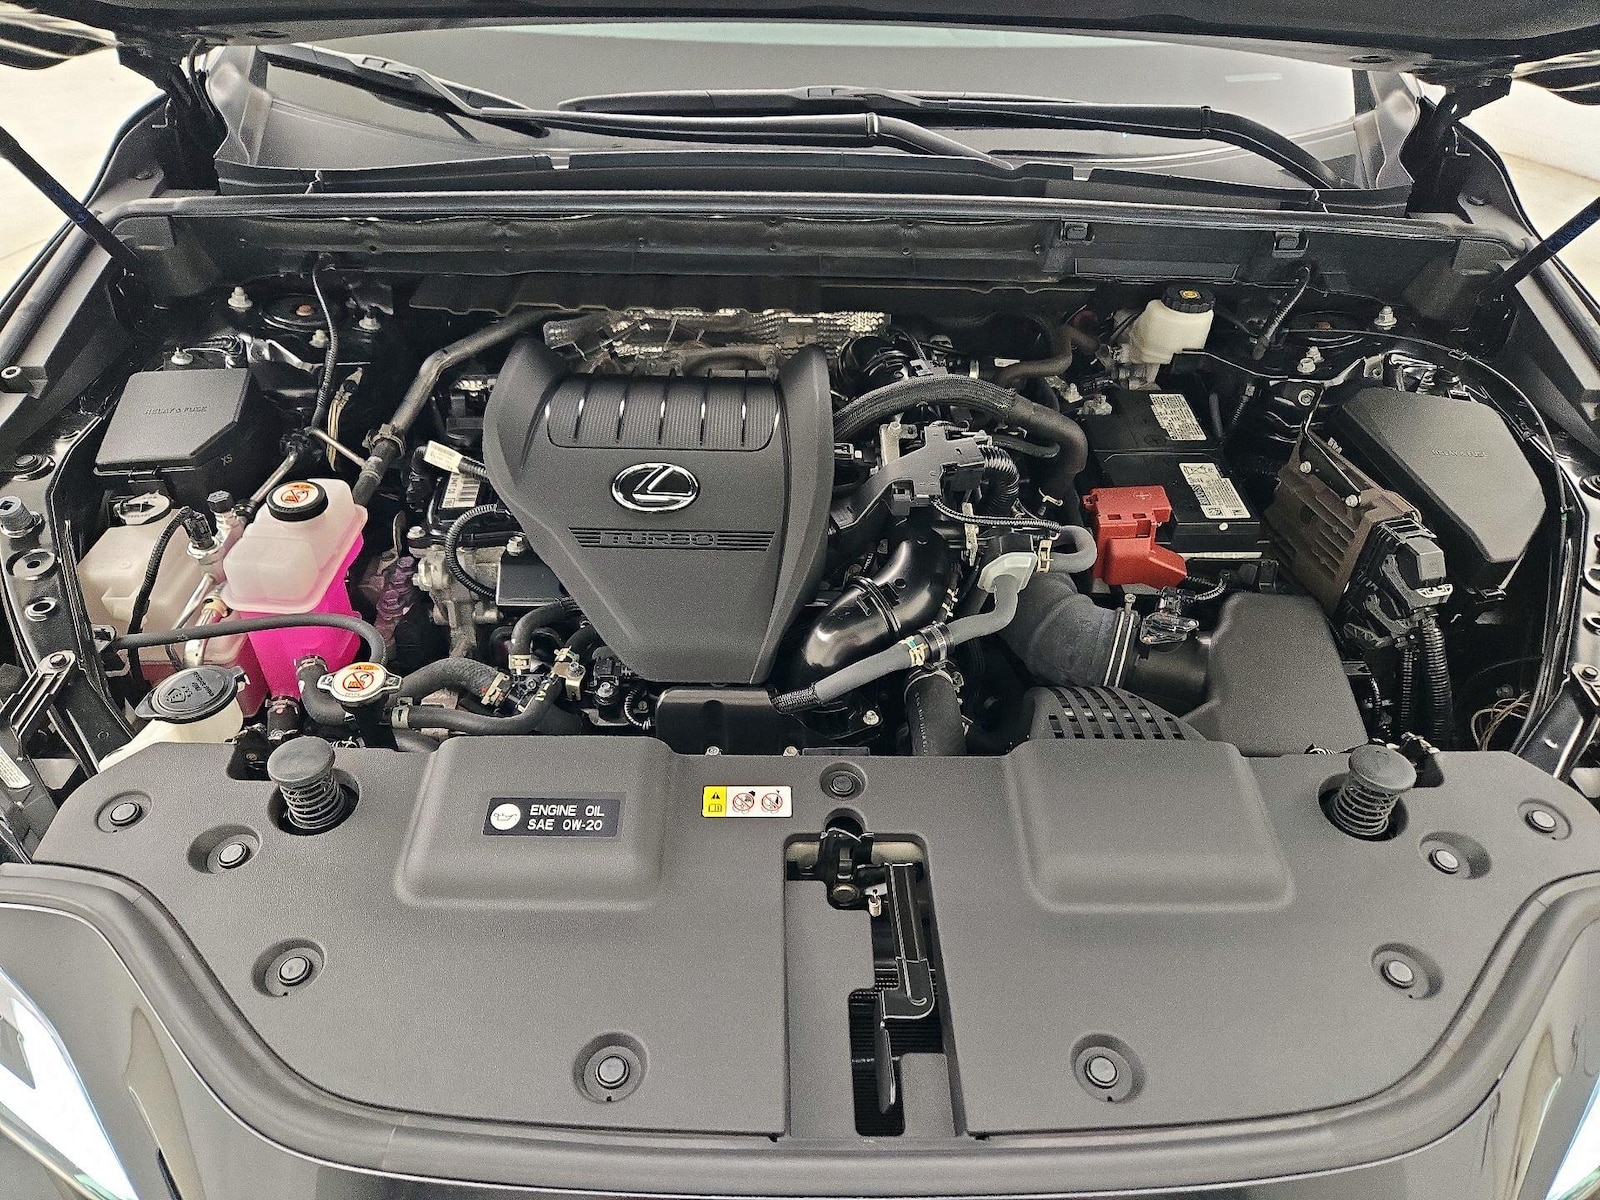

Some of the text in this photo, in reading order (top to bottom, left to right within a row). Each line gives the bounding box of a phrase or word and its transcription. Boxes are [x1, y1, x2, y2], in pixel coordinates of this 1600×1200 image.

[602, 532, 715, 546] TURBO
[529, 804, 605, 817] ENGINE OIL
[527, 819, 603, 831] SAE 0W-20
